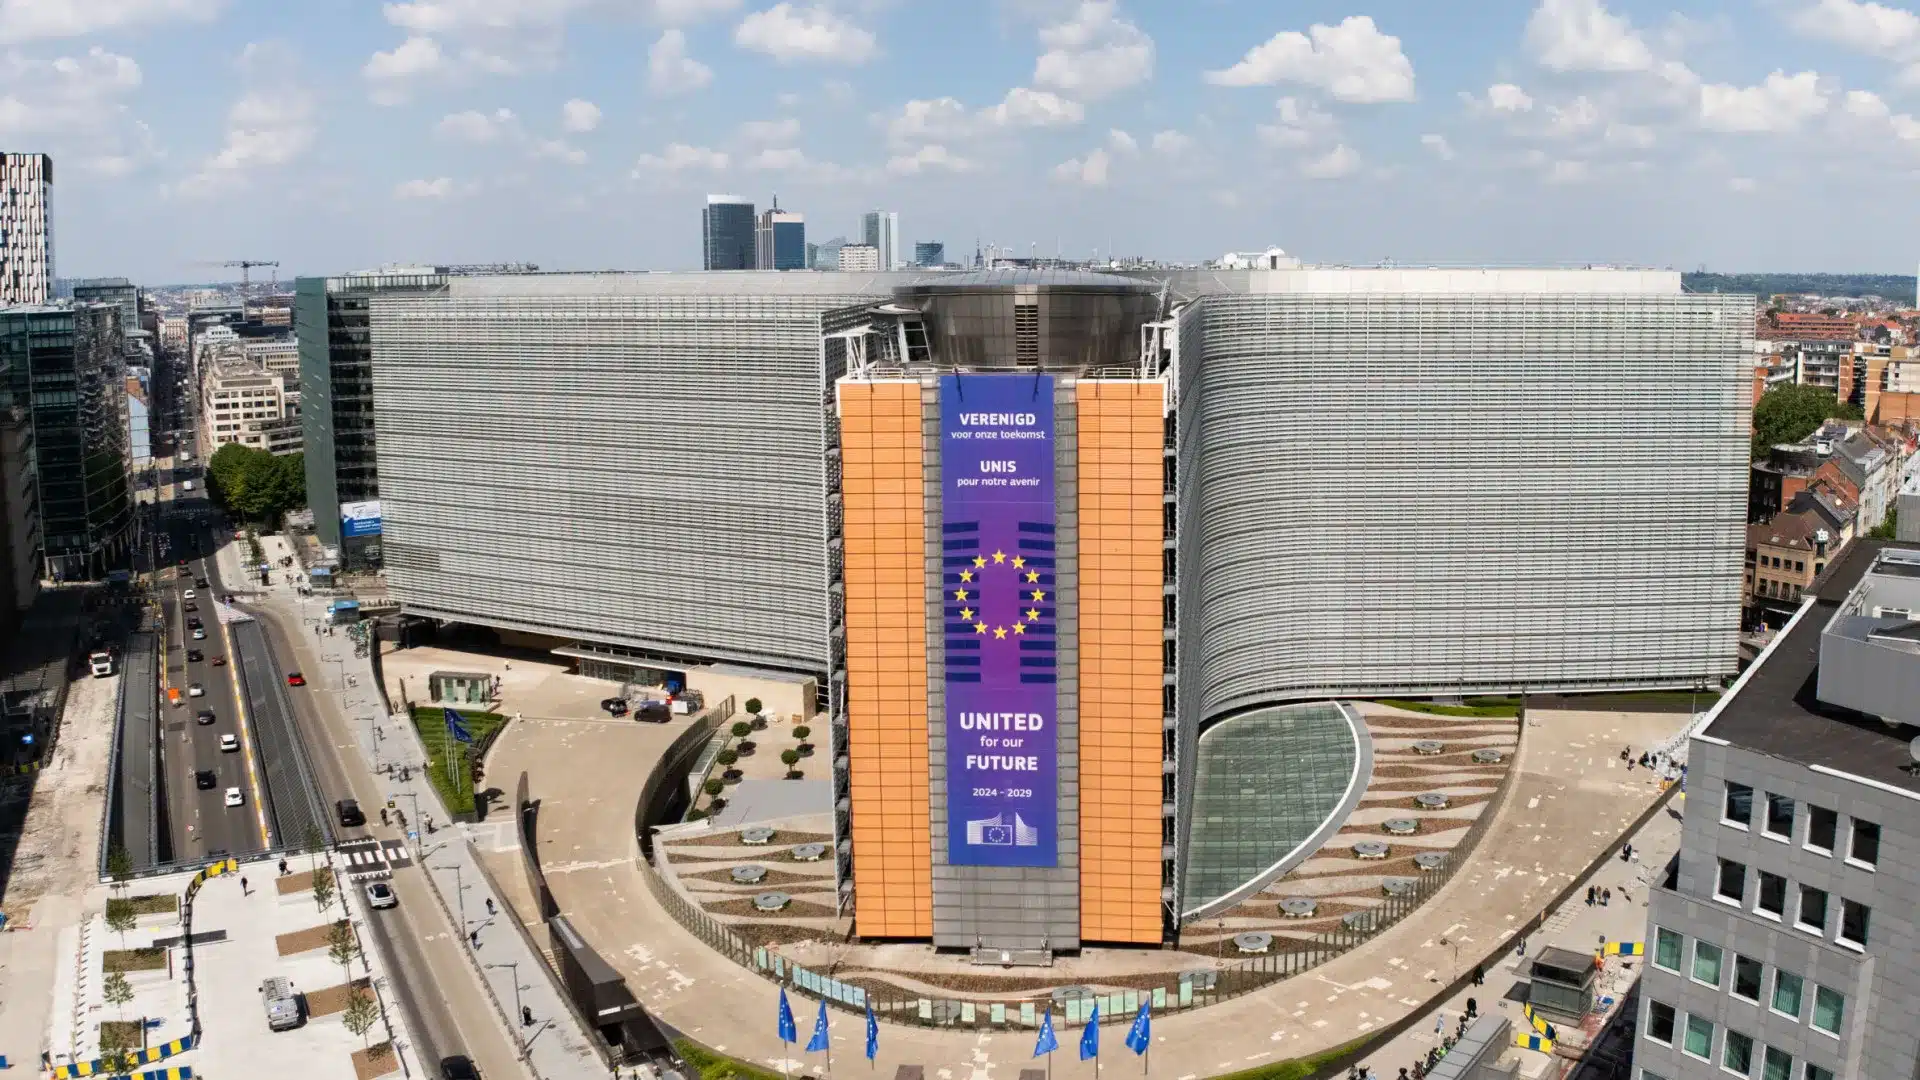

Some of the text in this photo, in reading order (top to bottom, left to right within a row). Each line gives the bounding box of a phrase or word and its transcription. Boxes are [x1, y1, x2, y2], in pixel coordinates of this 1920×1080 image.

[959, 413, 1036, 426] VERENIGD
[951, 429, 1046, 440] voor onze toekomst
[980, 460, 1017, 473] UNIS
[957, 477, 1040, 488] pour notre avenir
[959, 712, 1044, 731] UNITED
[980, 735, 1024, 748] for our
[966, 755, 1038, 771] FUTURE
[972, 787, 998, 797] 2024
[1007, 788, 1033, 798] 2029
